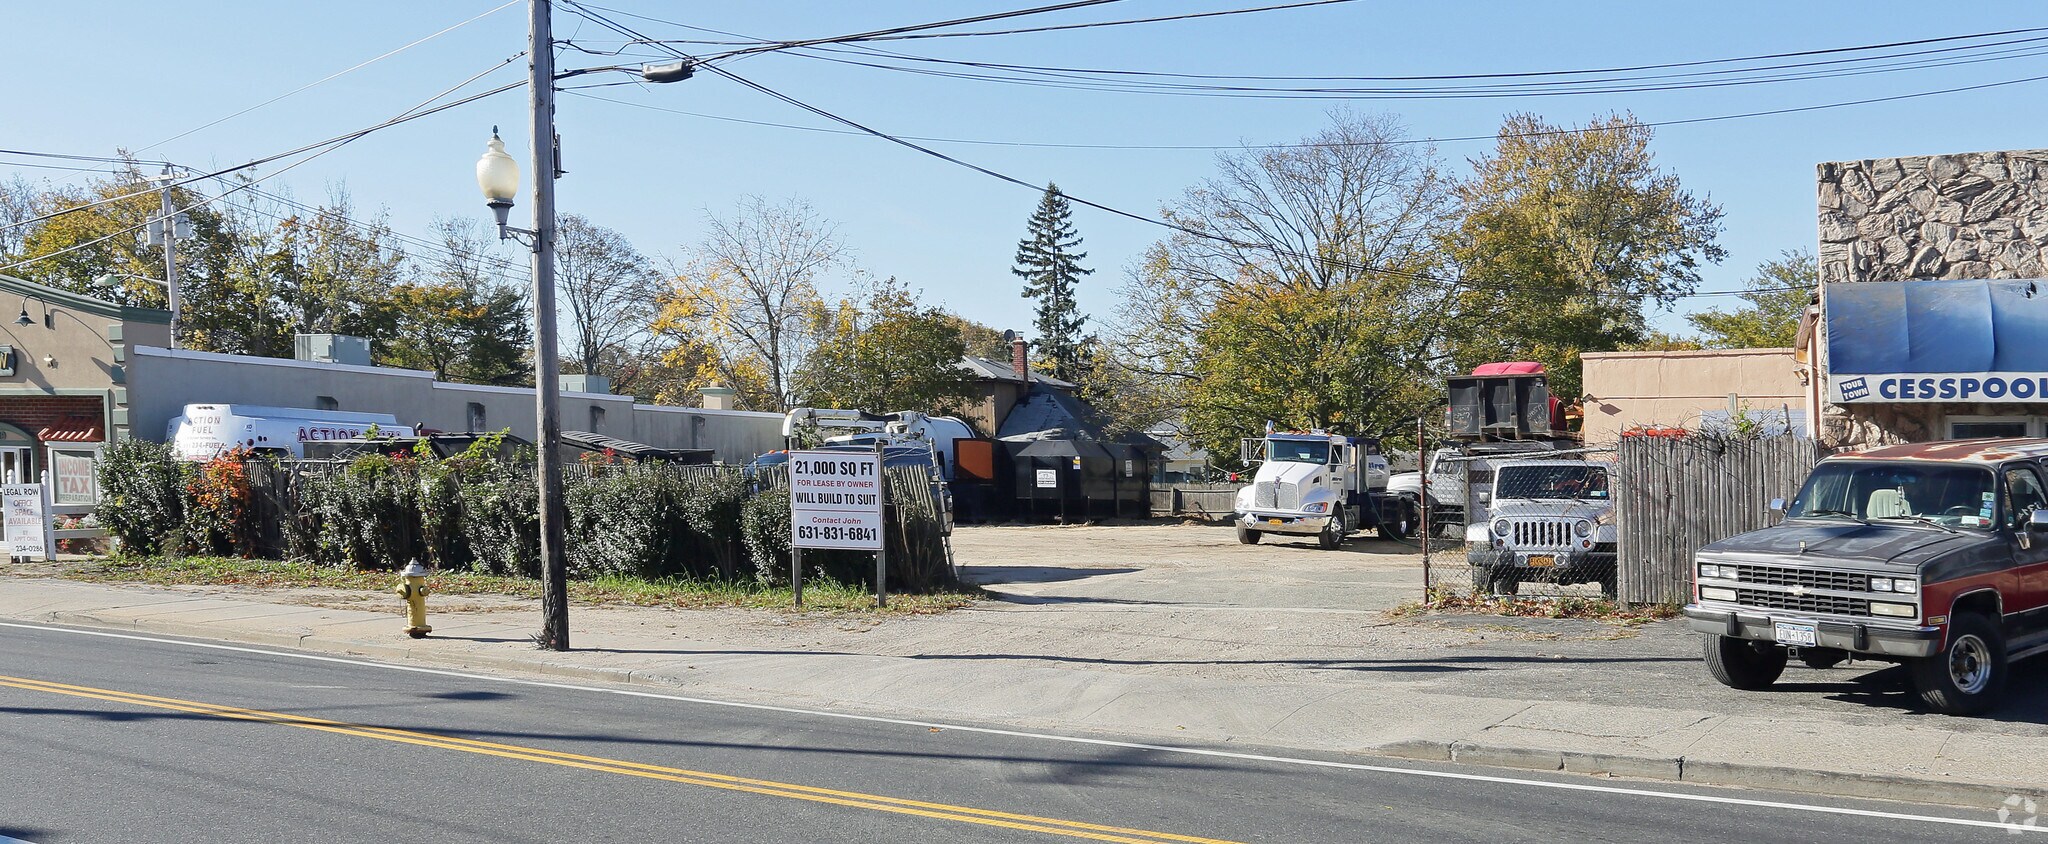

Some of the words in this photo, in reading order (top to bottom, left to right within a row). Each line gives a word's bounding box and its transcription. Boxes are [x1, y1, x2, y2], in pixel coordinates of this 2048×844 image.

[1841, 379, 1863, 390] YOUR
[1879, 377, 2048, 399] CESSPOOL
[1843, 388, 1869, 400] TOWN
[187, 416, 221, 426] ACTION
[192, 426, 213, 434] FUEL
[60, 459, 90, 476] INCOME
[795, 460, 836, 476] 21,000
[840, 461, 856, 477] SQ
[860, 462, 874, 476] FT
[60, 477, 90, 494] TAX
[797, 479, 812, 487] FOR
[3, 488, 21, 496] LEGAL
[13, 499, 33, 507] OFFICE
[795, 492, 816, 504] WILL
[818, 493, 842, 505] BUILD
[844, 493, 855, 505] TO
[857, 494, 877, 505] SUIT
[14, 508, 34, 516] SPACE
[8, 517, 42, 525] AVAILABLE
[812, 516, 841, 524] Contact
[842, 517, 862, 525] John
[798, 525, 877, 541] 631-831-6841
